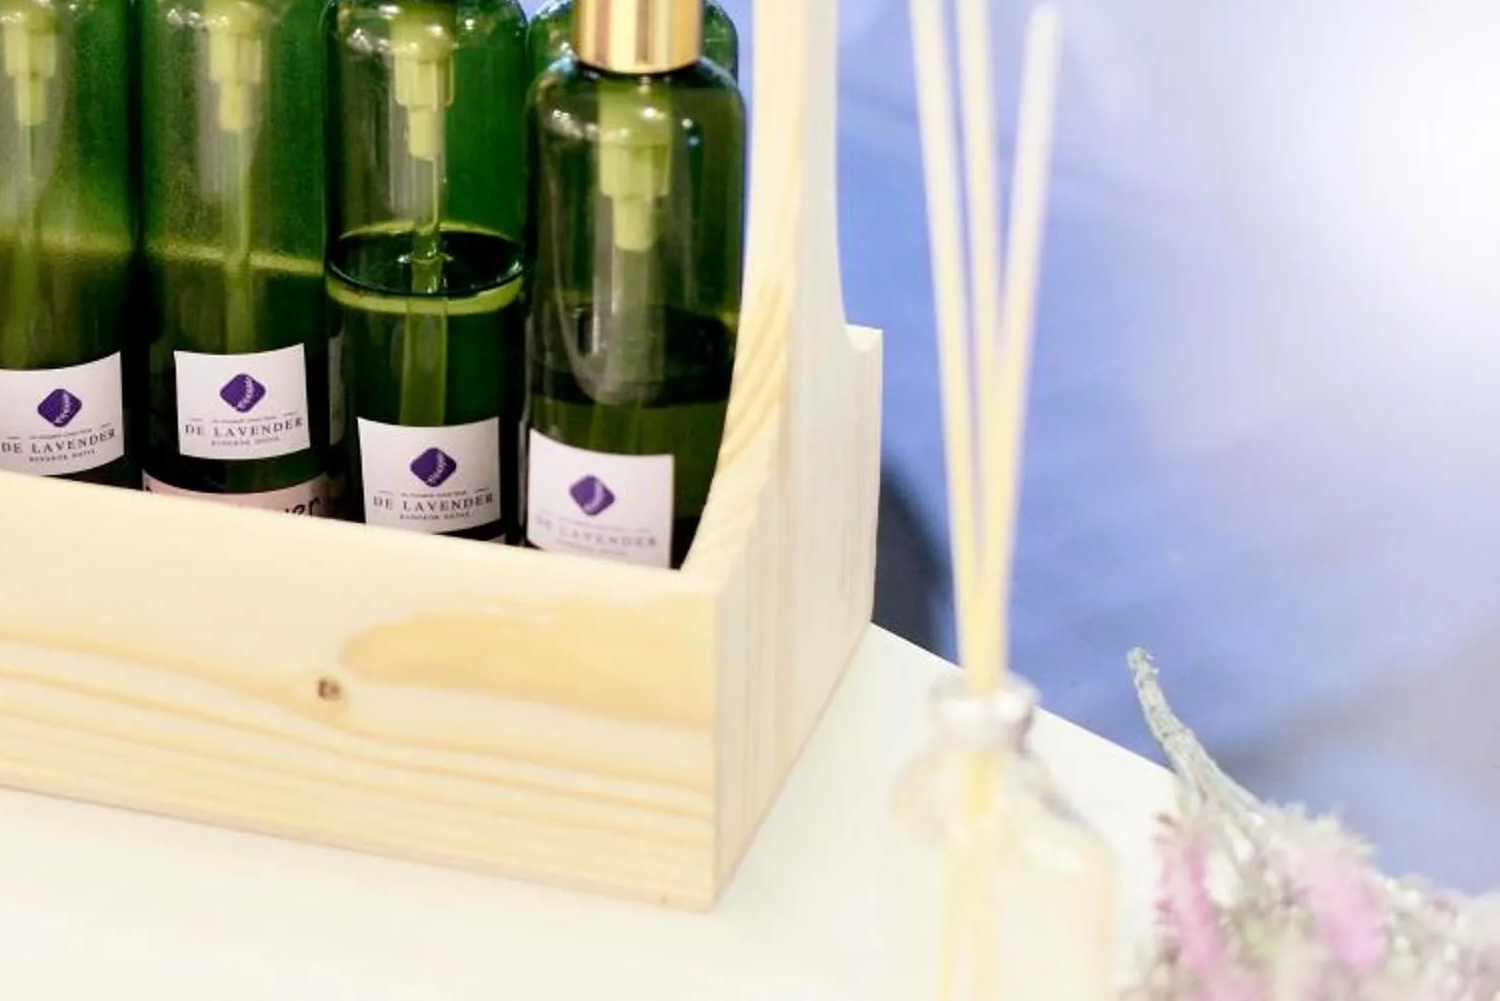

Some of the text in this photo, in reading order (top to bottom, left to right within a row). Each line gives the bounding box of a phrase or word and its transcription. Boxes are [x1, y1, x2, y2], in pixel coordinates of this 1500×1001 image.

[185, 423, 205, 436] DE
[213, 416, 304, 438] LAVENDER
[1, 441, 23, 454] DE
[31, 427, 117, 454] LAVENDER
[373, 495, 393, 510] DE
[403, 492, 494, 513] LAVENDER
